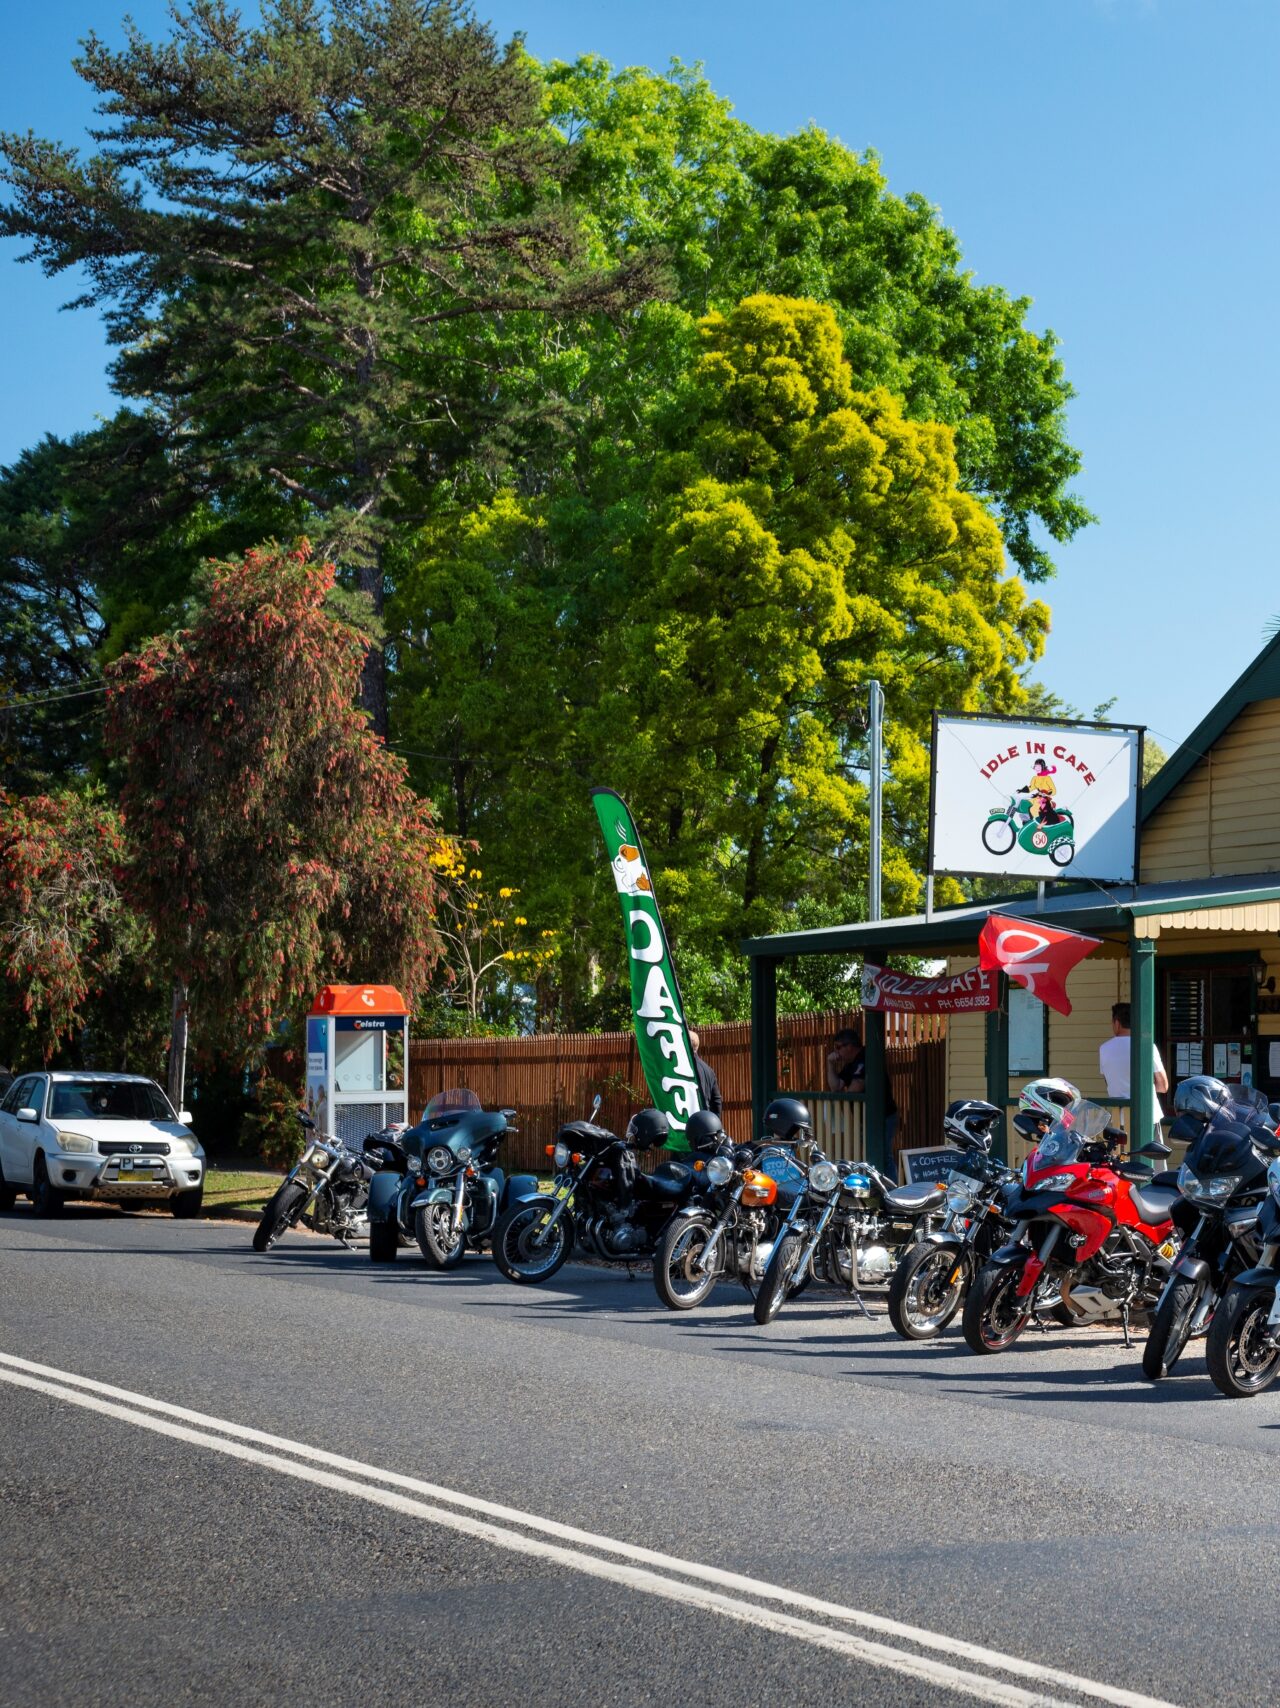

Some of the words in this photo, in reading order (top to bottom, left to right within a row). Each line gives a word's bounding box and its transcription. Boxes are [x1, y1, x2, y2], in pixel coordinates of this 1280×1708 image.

[980, 745, 1019, 779] IDLE
[1026, 741, 1046, 754] IN
[1053, 745, 1096, 786] CAFE
[1035, 834, 1046, 846] 30
[879, 974, 923, 995] IDLE
[936, 967, 990, 994] CAFE
[354, 1020, 385, 1029] Telstra
[122, 1158, 131, 1168] P
[919, 1155, 958, 1166] COFFEE
